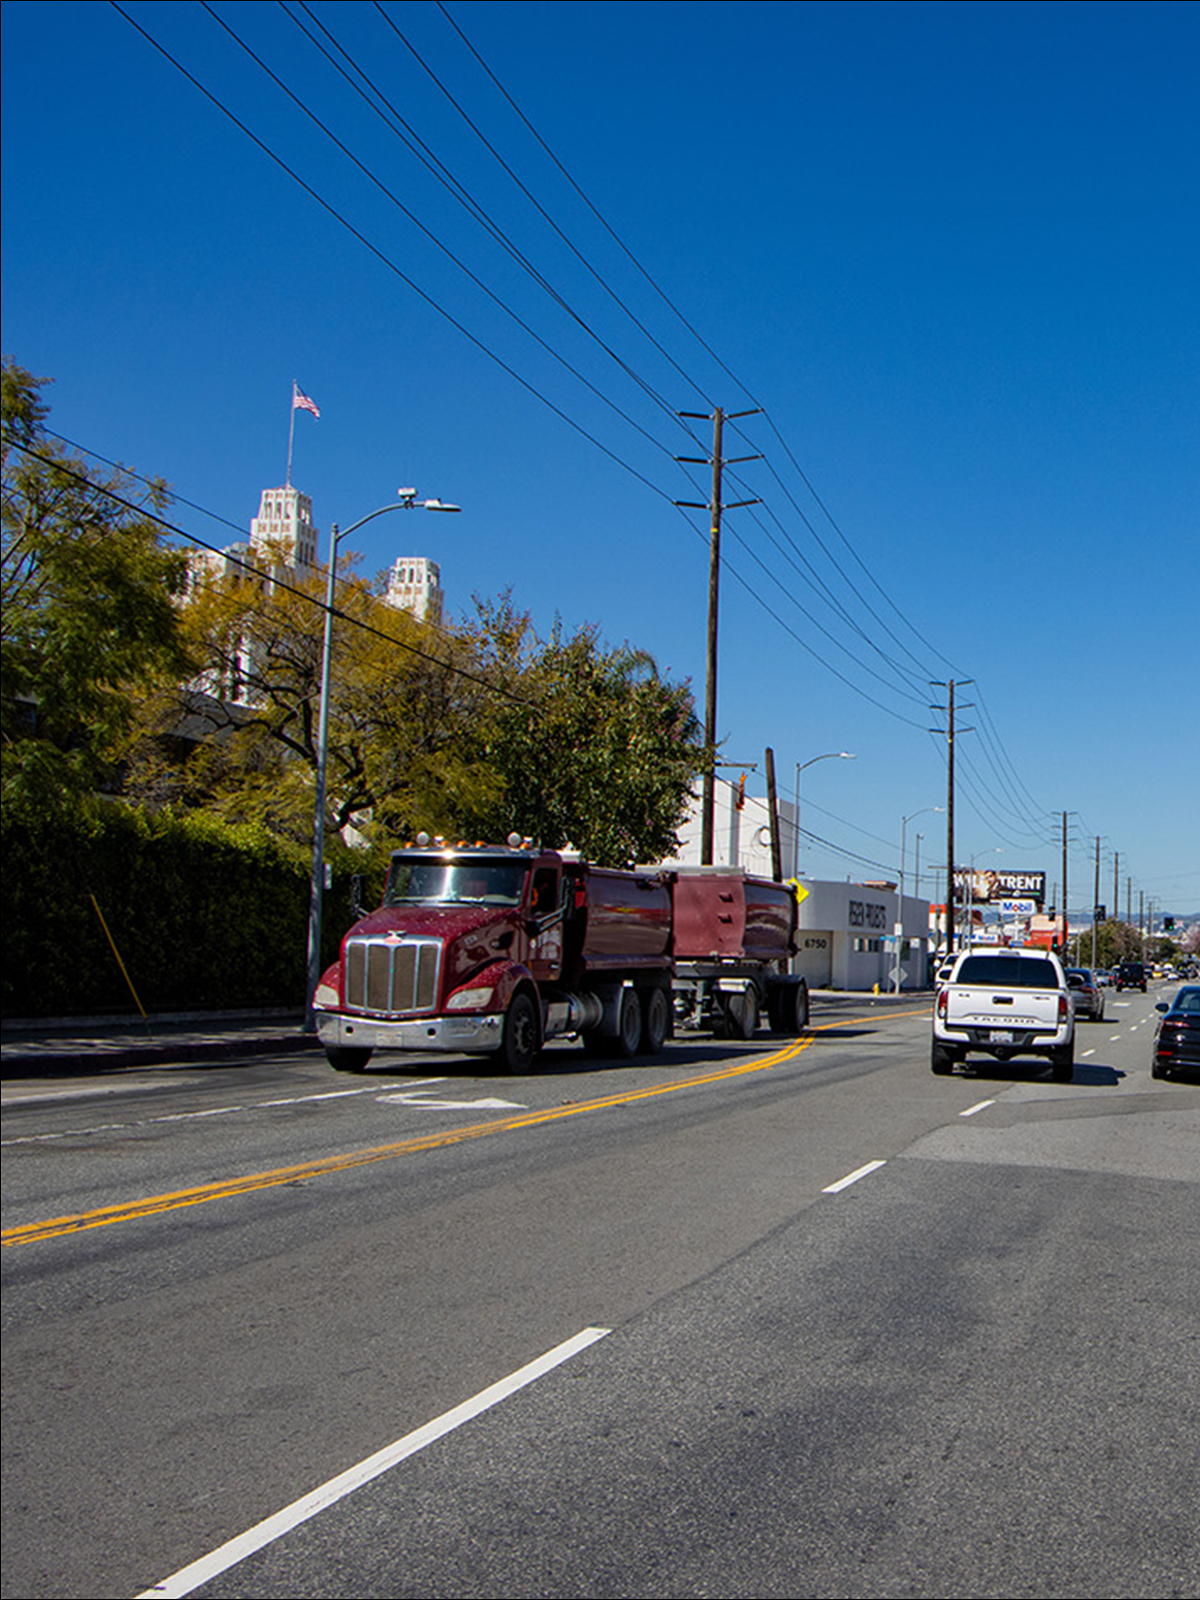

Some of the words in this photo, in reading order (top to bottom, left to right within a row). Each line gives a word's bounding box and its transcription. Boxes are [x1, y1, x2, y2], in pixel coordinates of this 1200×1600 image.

[998, 875, 1043, 890] TRENT
[1003, 902, 1033, 912] Mobil
[804, 938, 828, 949] 6750
